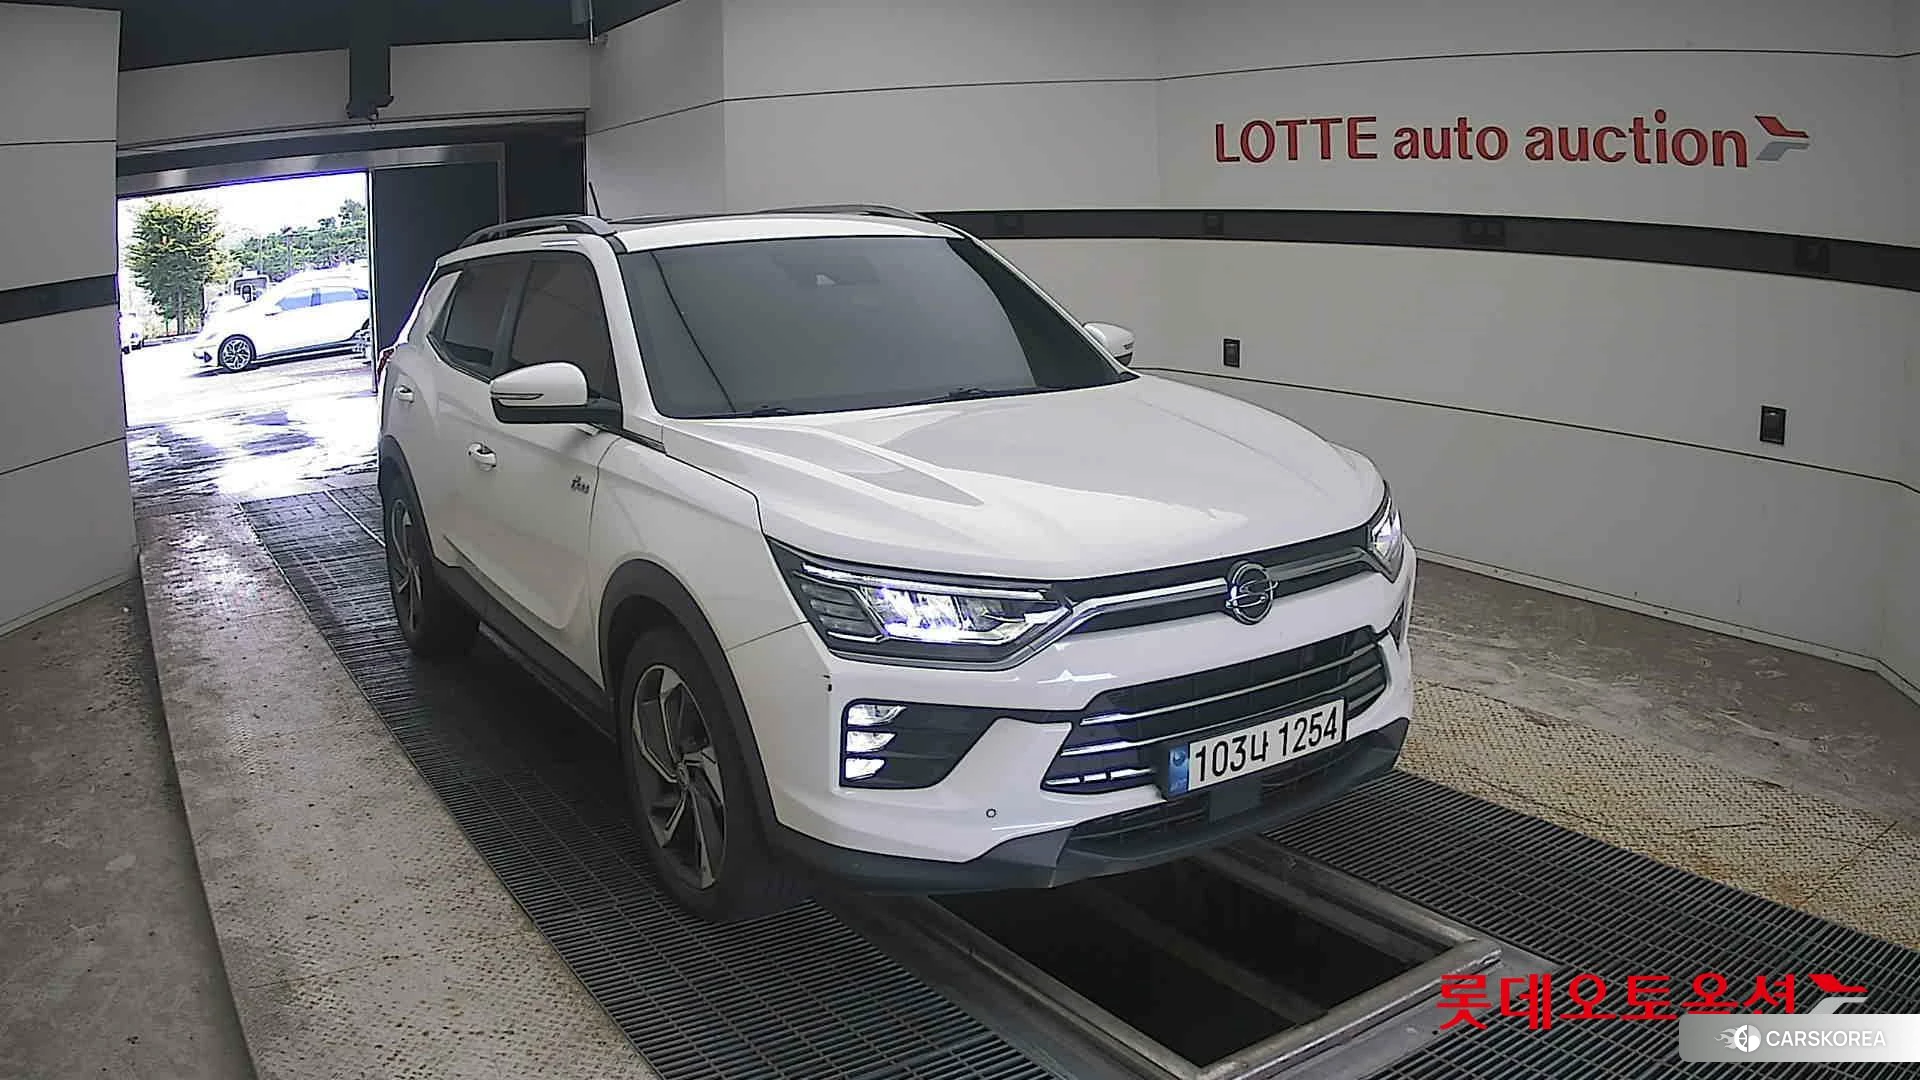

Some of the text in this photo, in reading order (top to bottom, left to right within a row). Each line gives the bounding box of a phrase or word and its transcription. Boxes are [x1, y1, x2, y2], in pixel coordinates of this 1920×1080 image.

[1215, 109, 1748, 168] LOTTE auto auction
[1278, 706, 1338, 757] 1254
